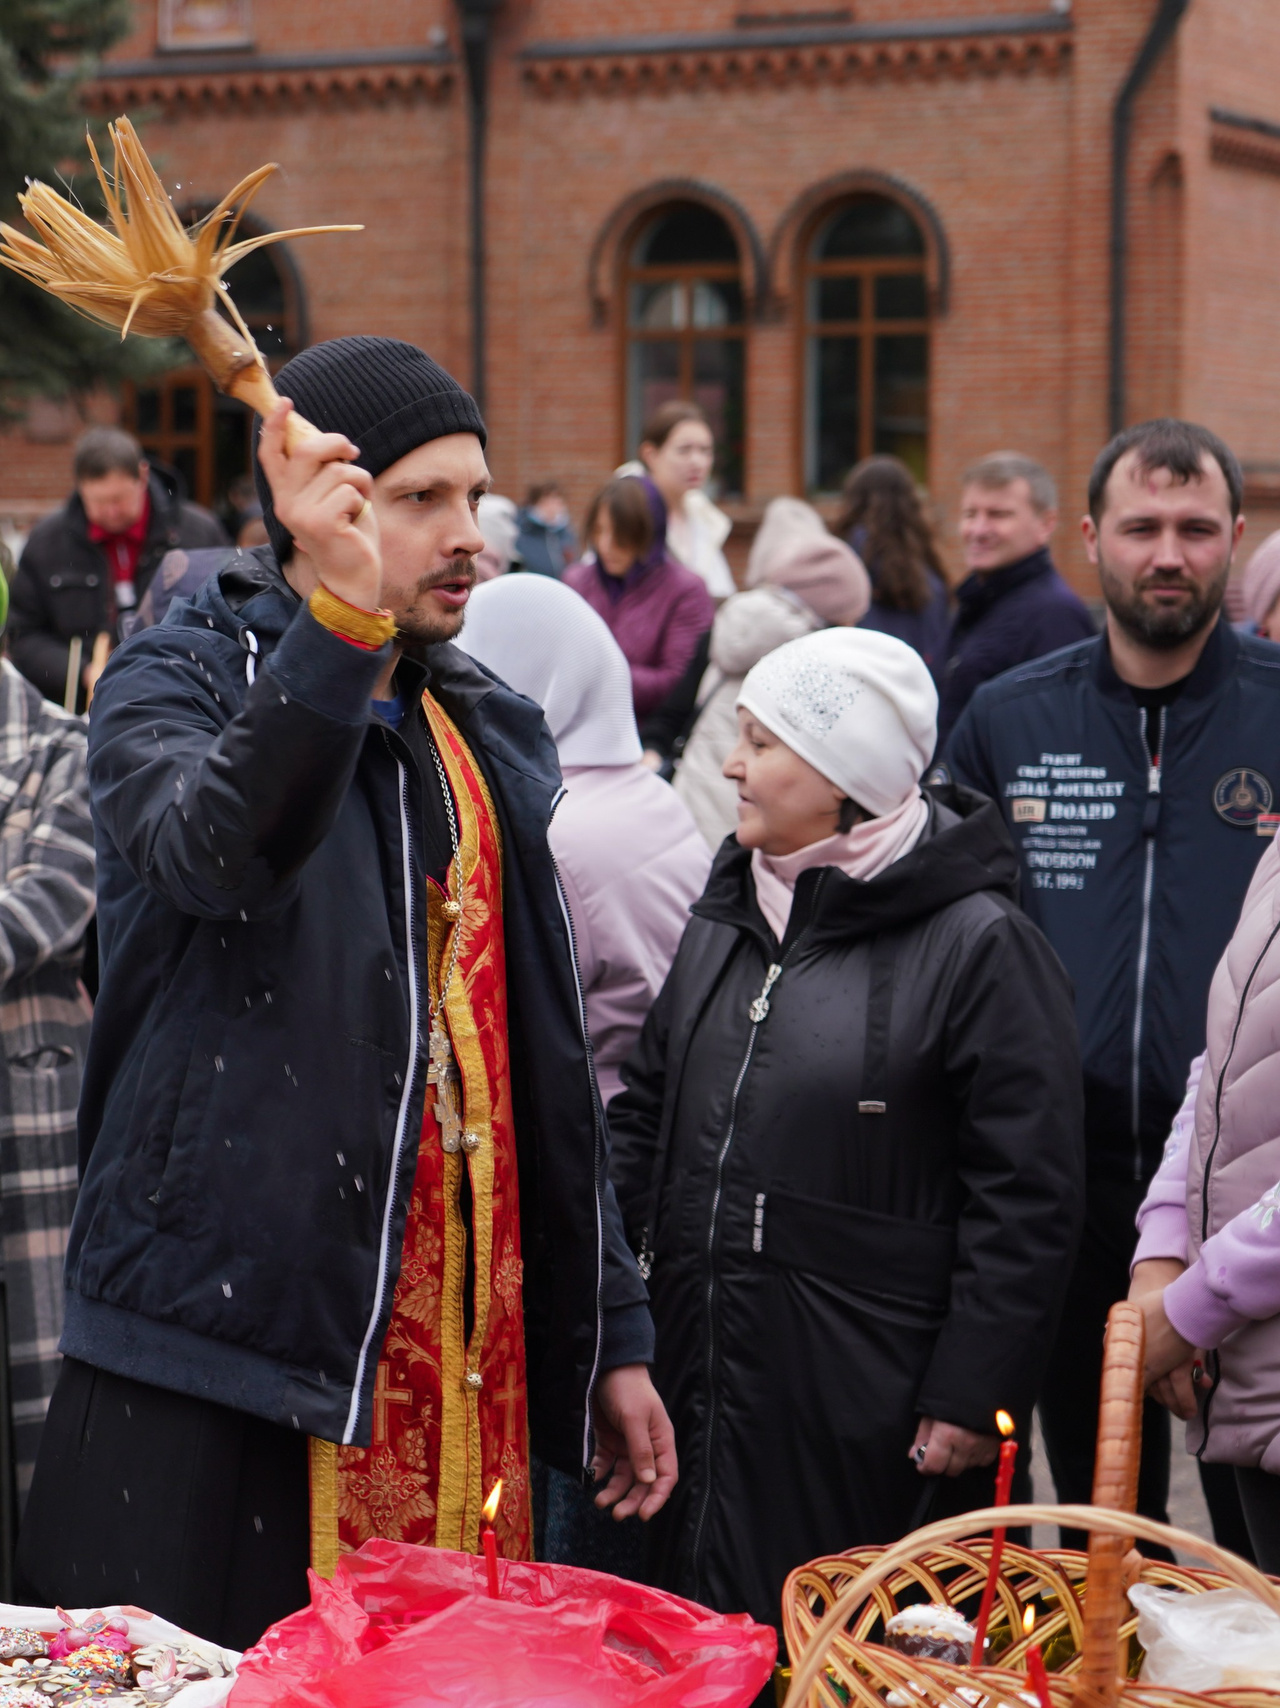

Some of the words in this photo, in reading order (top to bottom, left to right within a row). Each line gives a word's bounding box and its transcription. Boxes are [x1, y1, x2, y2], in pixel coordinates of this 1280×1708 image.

[1040, 753, 1082, 766] FLIGHT
[1017, 766, 1048, 778] CREW
[1051, 767, 1107, 779] MEMBERS
[1005, 781, 1051, 797] AERIAL
[1053, 782, 1125, 797] JOURNEY
[1050, 802, 1116, 819] BOARD
